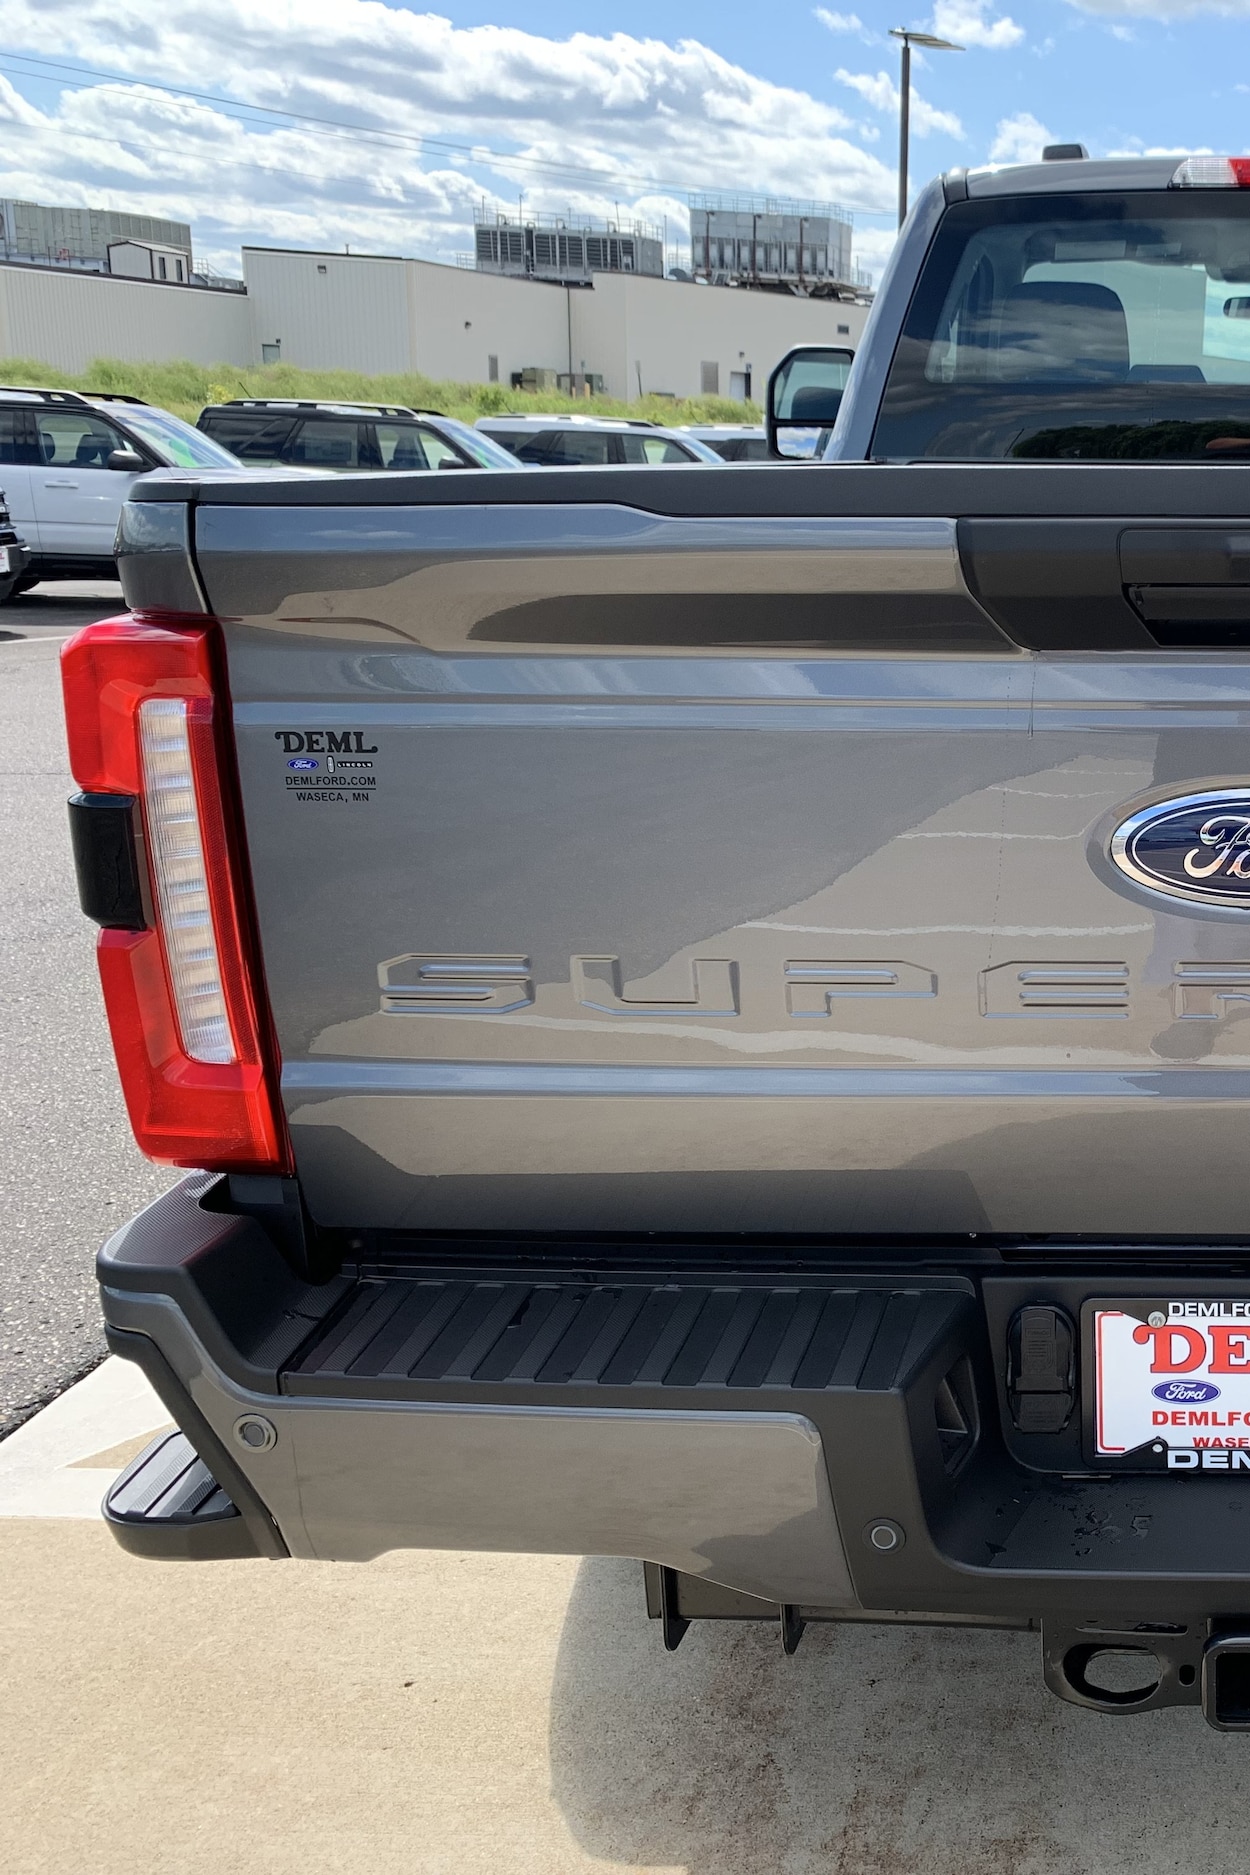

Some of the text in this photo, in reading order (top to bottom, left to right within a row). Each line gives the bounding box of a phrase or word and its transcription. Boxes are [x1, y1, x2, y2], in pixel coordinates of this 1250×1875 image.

[275, 731, 378, 753] DEML
[285, 776, 376, 786] DEMLFORD.COM
[296, 792, 369, 803] WASECA, MN
